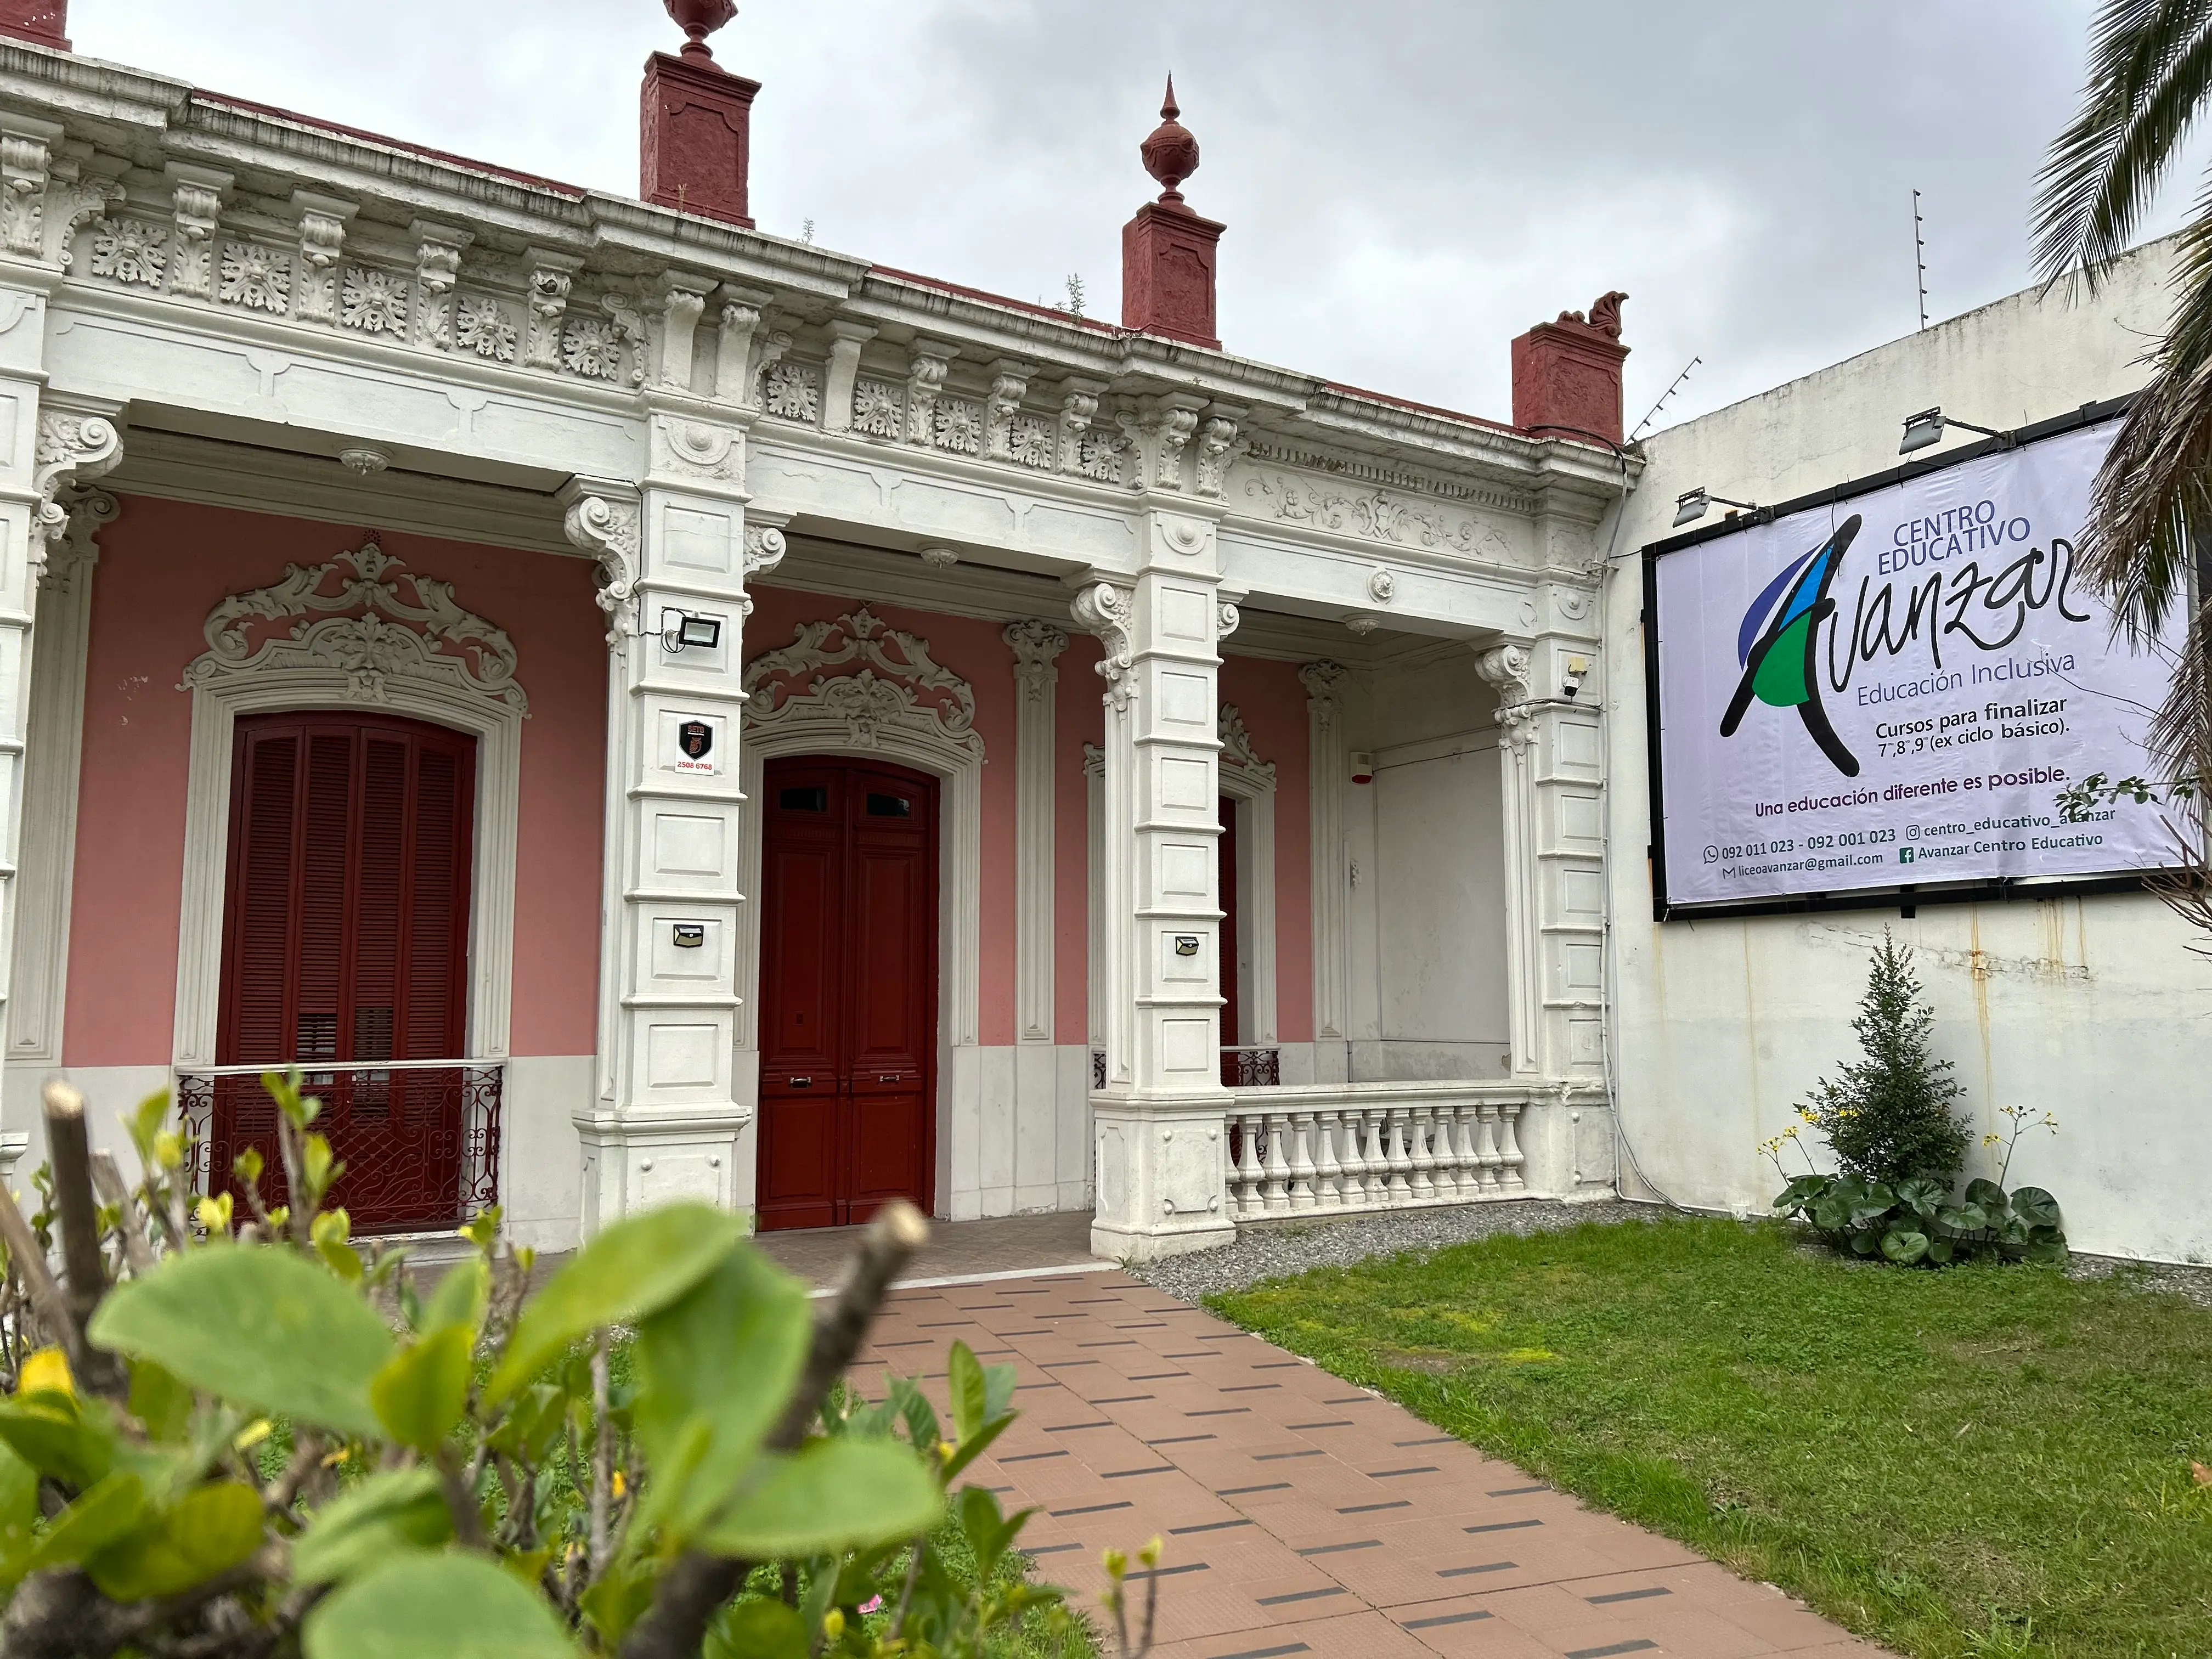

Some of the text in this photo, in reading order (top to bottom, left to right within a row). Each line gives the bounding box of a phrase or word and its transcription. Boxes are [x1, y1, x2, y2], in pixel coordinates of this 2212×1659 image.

[1894, 500, 1995, 546] CENTRO
[1878, 517, 2030, 575] EDUCATIVO
[1719, 514, 2090, 777] Avanzar
[1858, 652, 2074, 706] Educación Inclusiva
[1876, 698, 2067, 738] Cursos para finalizar
[1957, 726, 1994, 744] ciclo
[2002, 718, 2069, 738] básico).
[1756, 766, 2070, 817] Una educación diferente es posible.
[1924, 809, 2115, 837] centro_educativo_aanzar
[1722, 846, 1743, 859] 092
[1746, 843, 1767, 857] 011
[1770, 839, 1794, 853] 023
[1808, 835, 1834, 849] 092
[1838, 831, 1865, 847] 001
[1869, 828, 1896, 843] 023
[1918, 833, 2103, 859] Avanzar Centro Educativo
[1738, 853, 1883, 877] liceoavanzar@gmail.com
